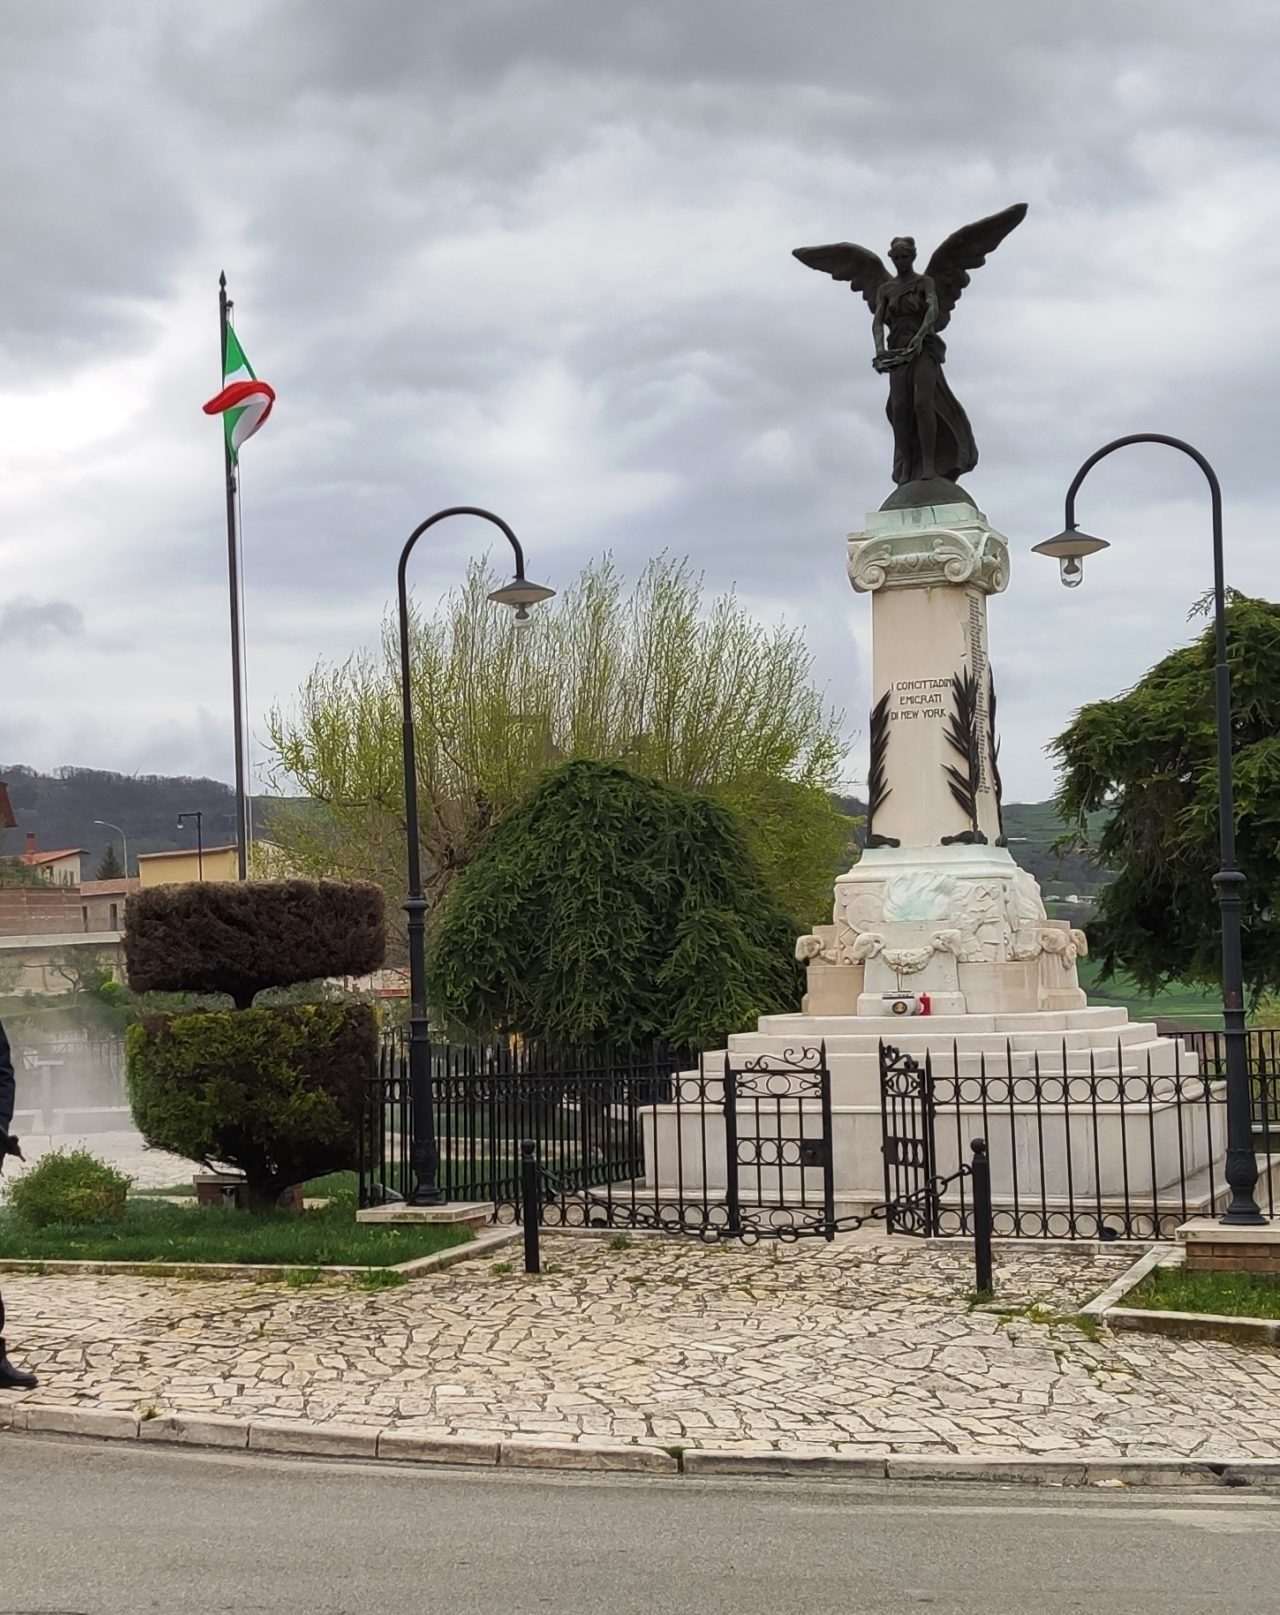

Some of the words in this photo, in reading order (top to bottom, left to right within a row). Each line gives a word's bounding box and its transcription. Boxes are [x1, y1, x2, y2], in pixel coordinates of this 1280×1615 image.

[891, 711, 899, 721] DI
[901, 710, 919, 720] NEW
[922, 708, 946, 718] YORK
